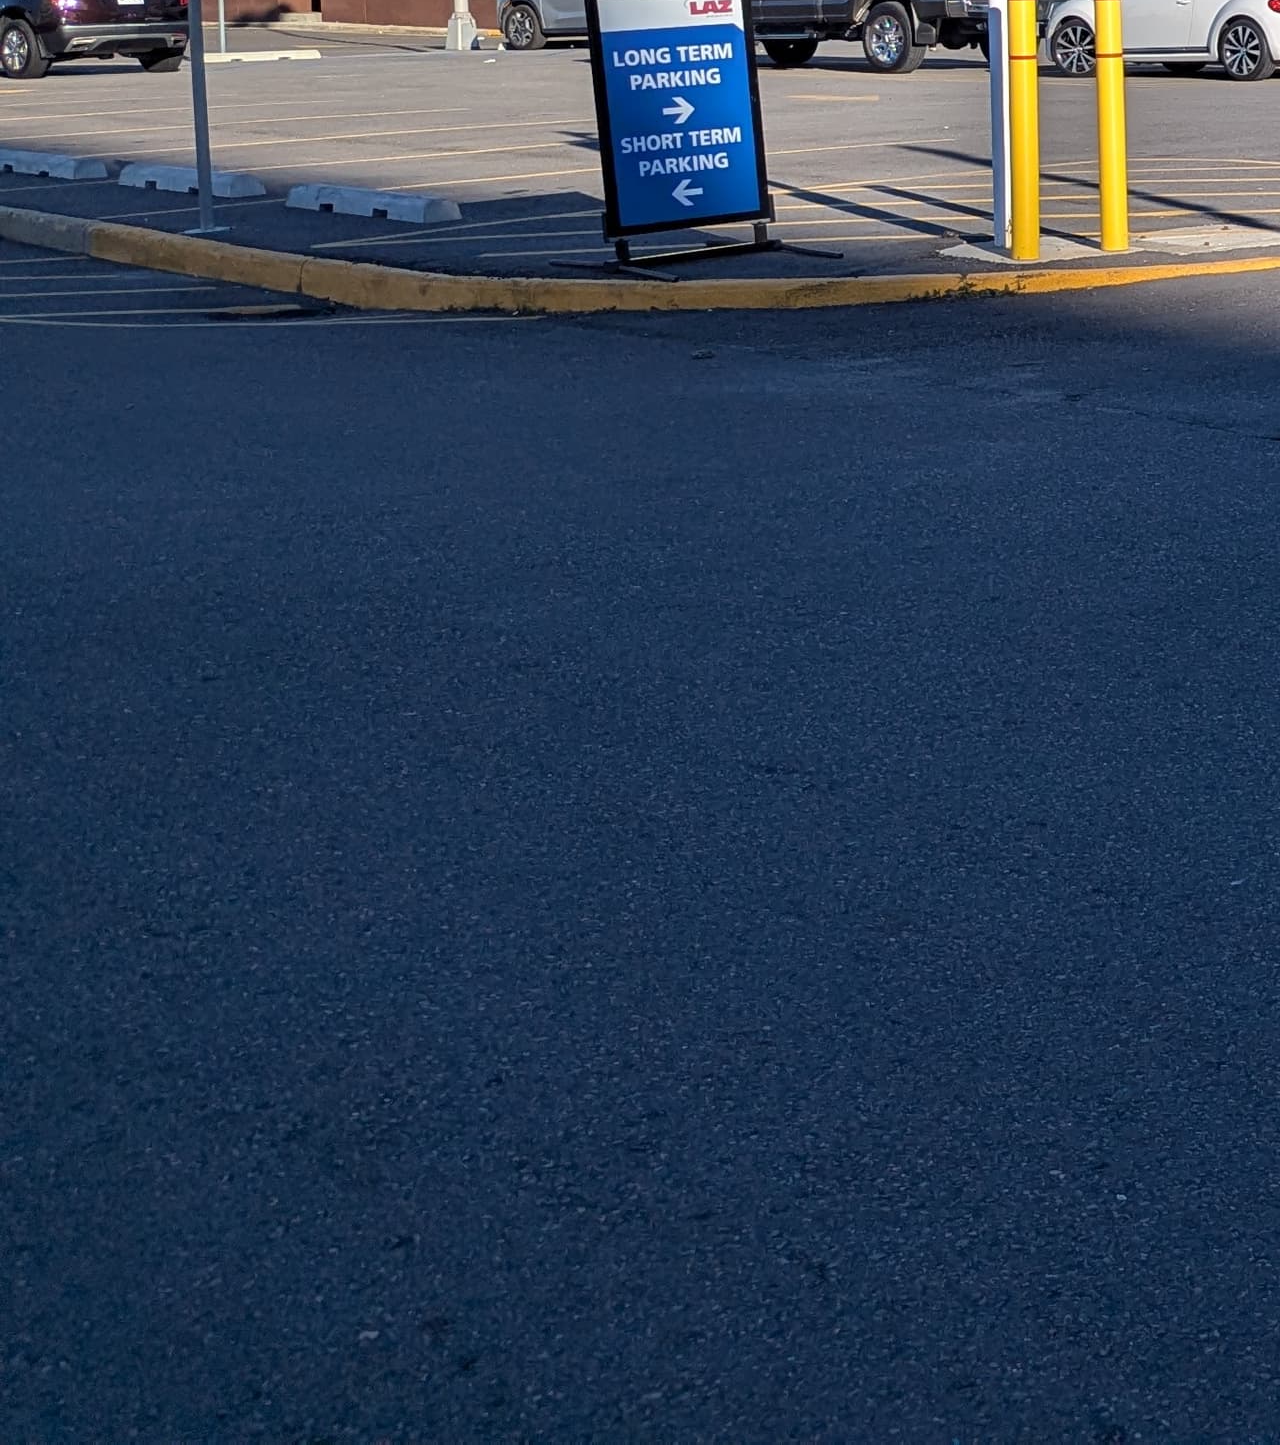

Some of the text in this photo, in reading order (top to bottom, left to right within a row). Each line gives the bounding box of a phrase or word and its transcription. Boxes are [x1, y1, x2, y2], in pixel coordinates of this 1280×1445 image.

[689, 0, 733, 15] LAZ
[612, 42, 734, 68] LONG TERM
[629, 67, 721, 91] PARKING
[620, 126, 742, 154] SHORT TERM
[638, 152, 729, 178] PARKING
